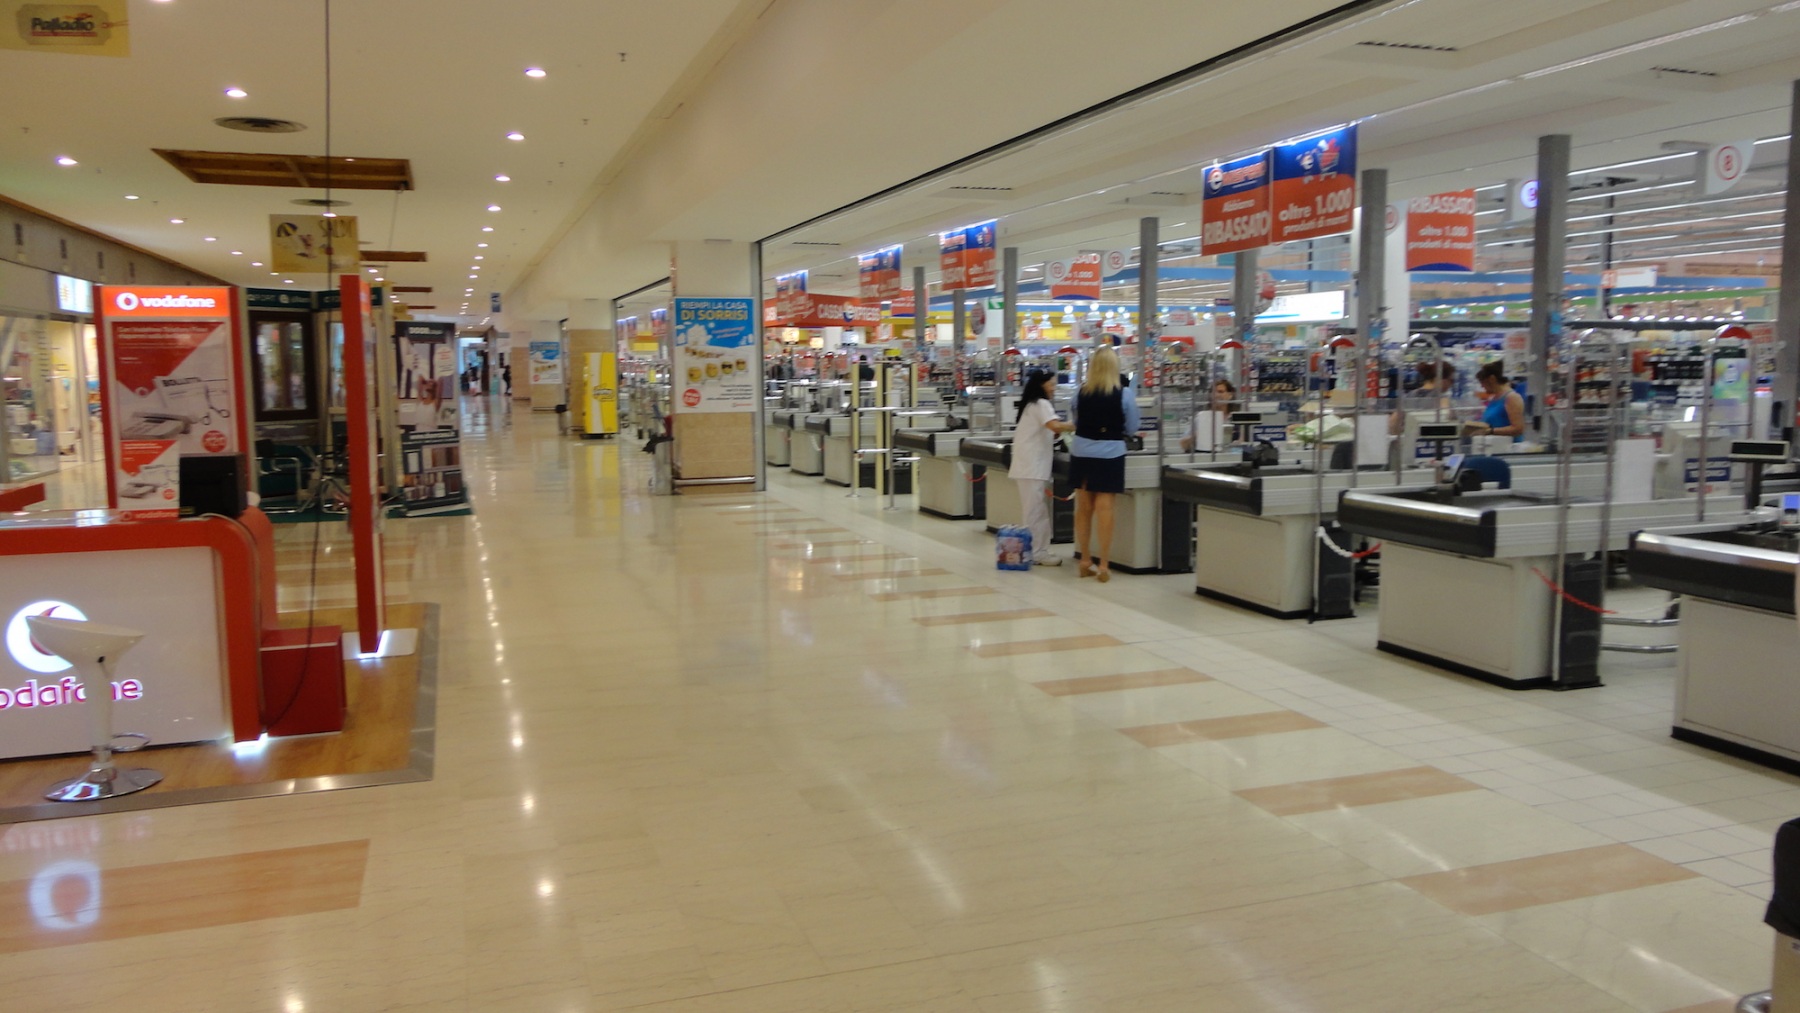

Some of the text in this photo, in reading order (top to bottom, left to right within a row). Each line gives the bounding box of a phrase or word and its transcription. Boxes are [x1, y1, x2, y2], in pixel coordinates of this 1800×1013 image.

[31, 17, 95, 32] Palladio
[1279, 187, 1352, 222] oltre 1.000
[1408, 196, 1476, 215] RIBASSATO
[1204, 210, 1271, 246] RIBASSATO
[1418, 225, 1443, 236] oltre
[140, 295, 216, 308] vodafone
[681, 310, 747, 321] DI SORRISI
[817, 303, 843, 319] CASSA
[0, 676, 143, 711] odafoe
